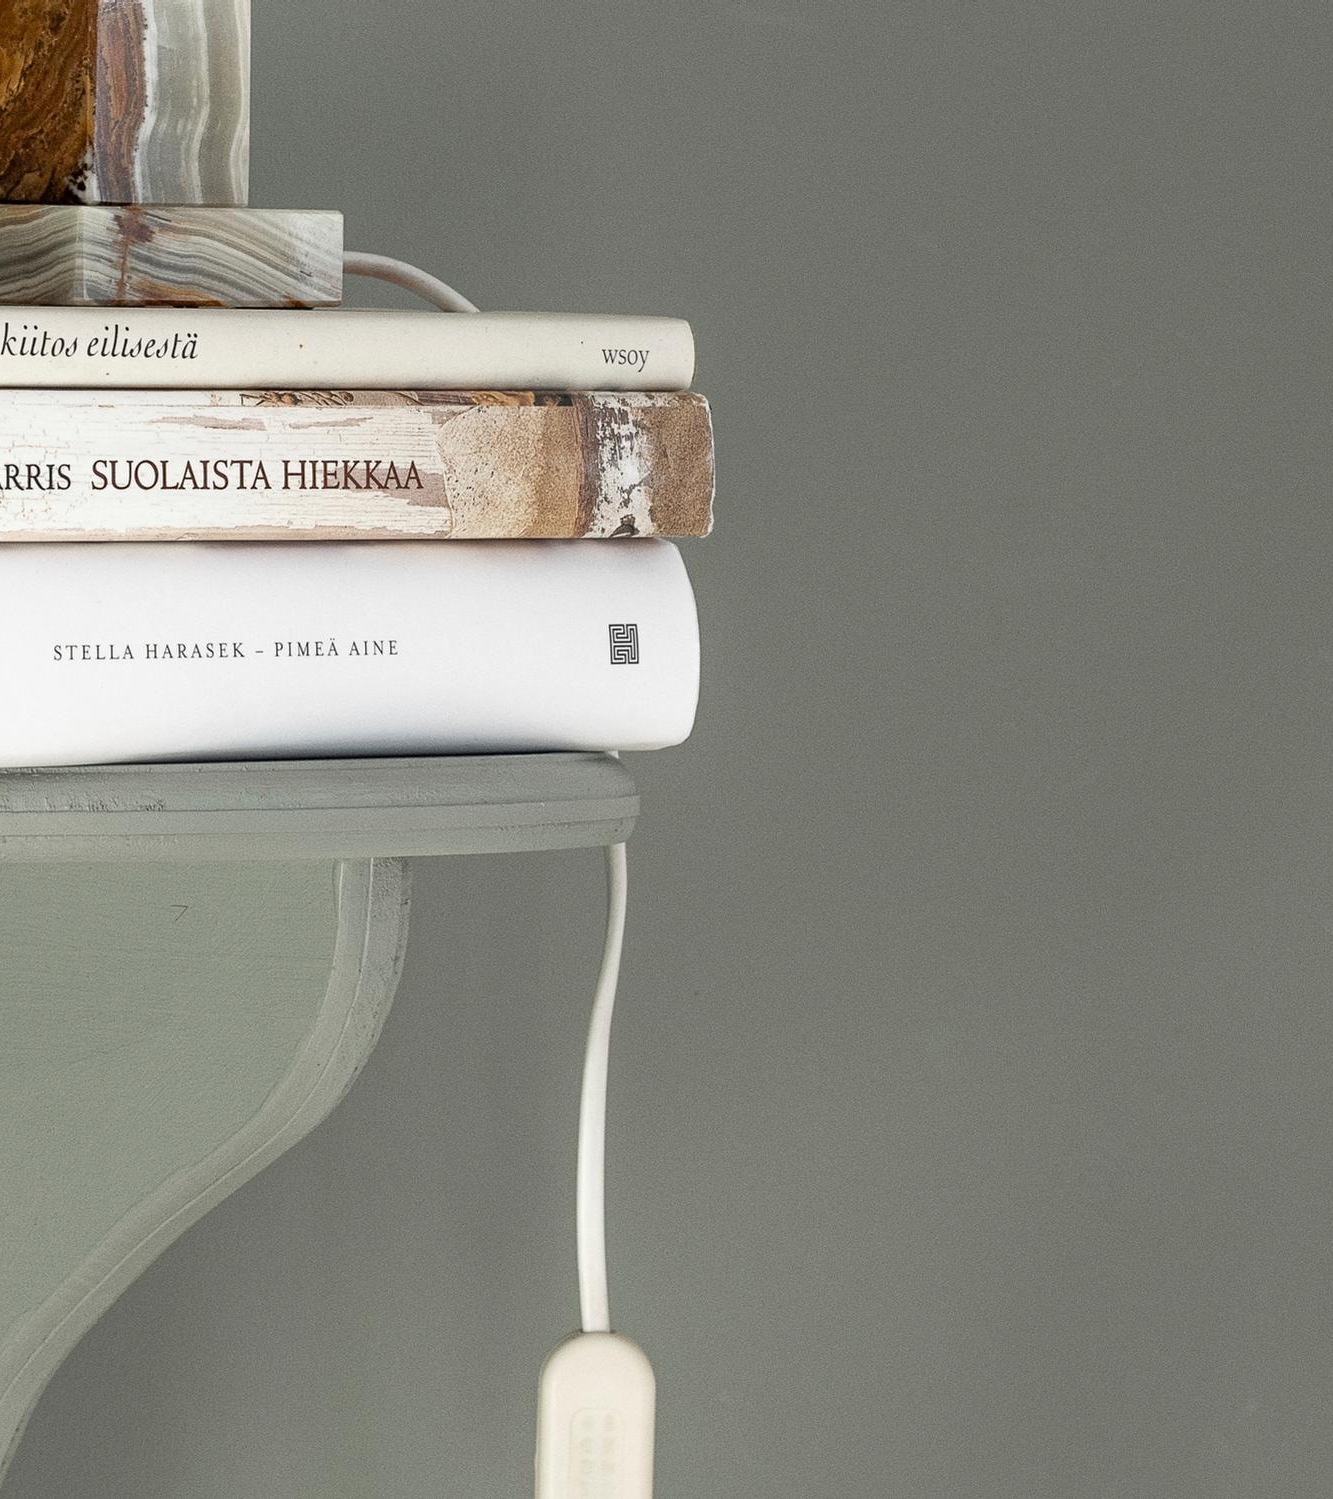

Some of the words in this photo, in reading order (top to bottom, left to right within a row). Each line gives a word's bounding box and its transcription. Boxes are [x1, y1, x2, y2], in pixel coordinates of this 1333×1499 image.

[0, 322, 78, 358] kiitos
[86, 323, 198, 360] eilisestä
[601, 348, 650, 373] wsoy
[91, 459, 271, 491] SUOLAISTA
[282, 459, 425, 491] HIEKKAA
[53, 644, 135, 661] STELLA
[146, 642, 246, 660] HARASEK
[274, 637, 340, 657] PIMEÄ
[349, 640, 399, 657] AINE
